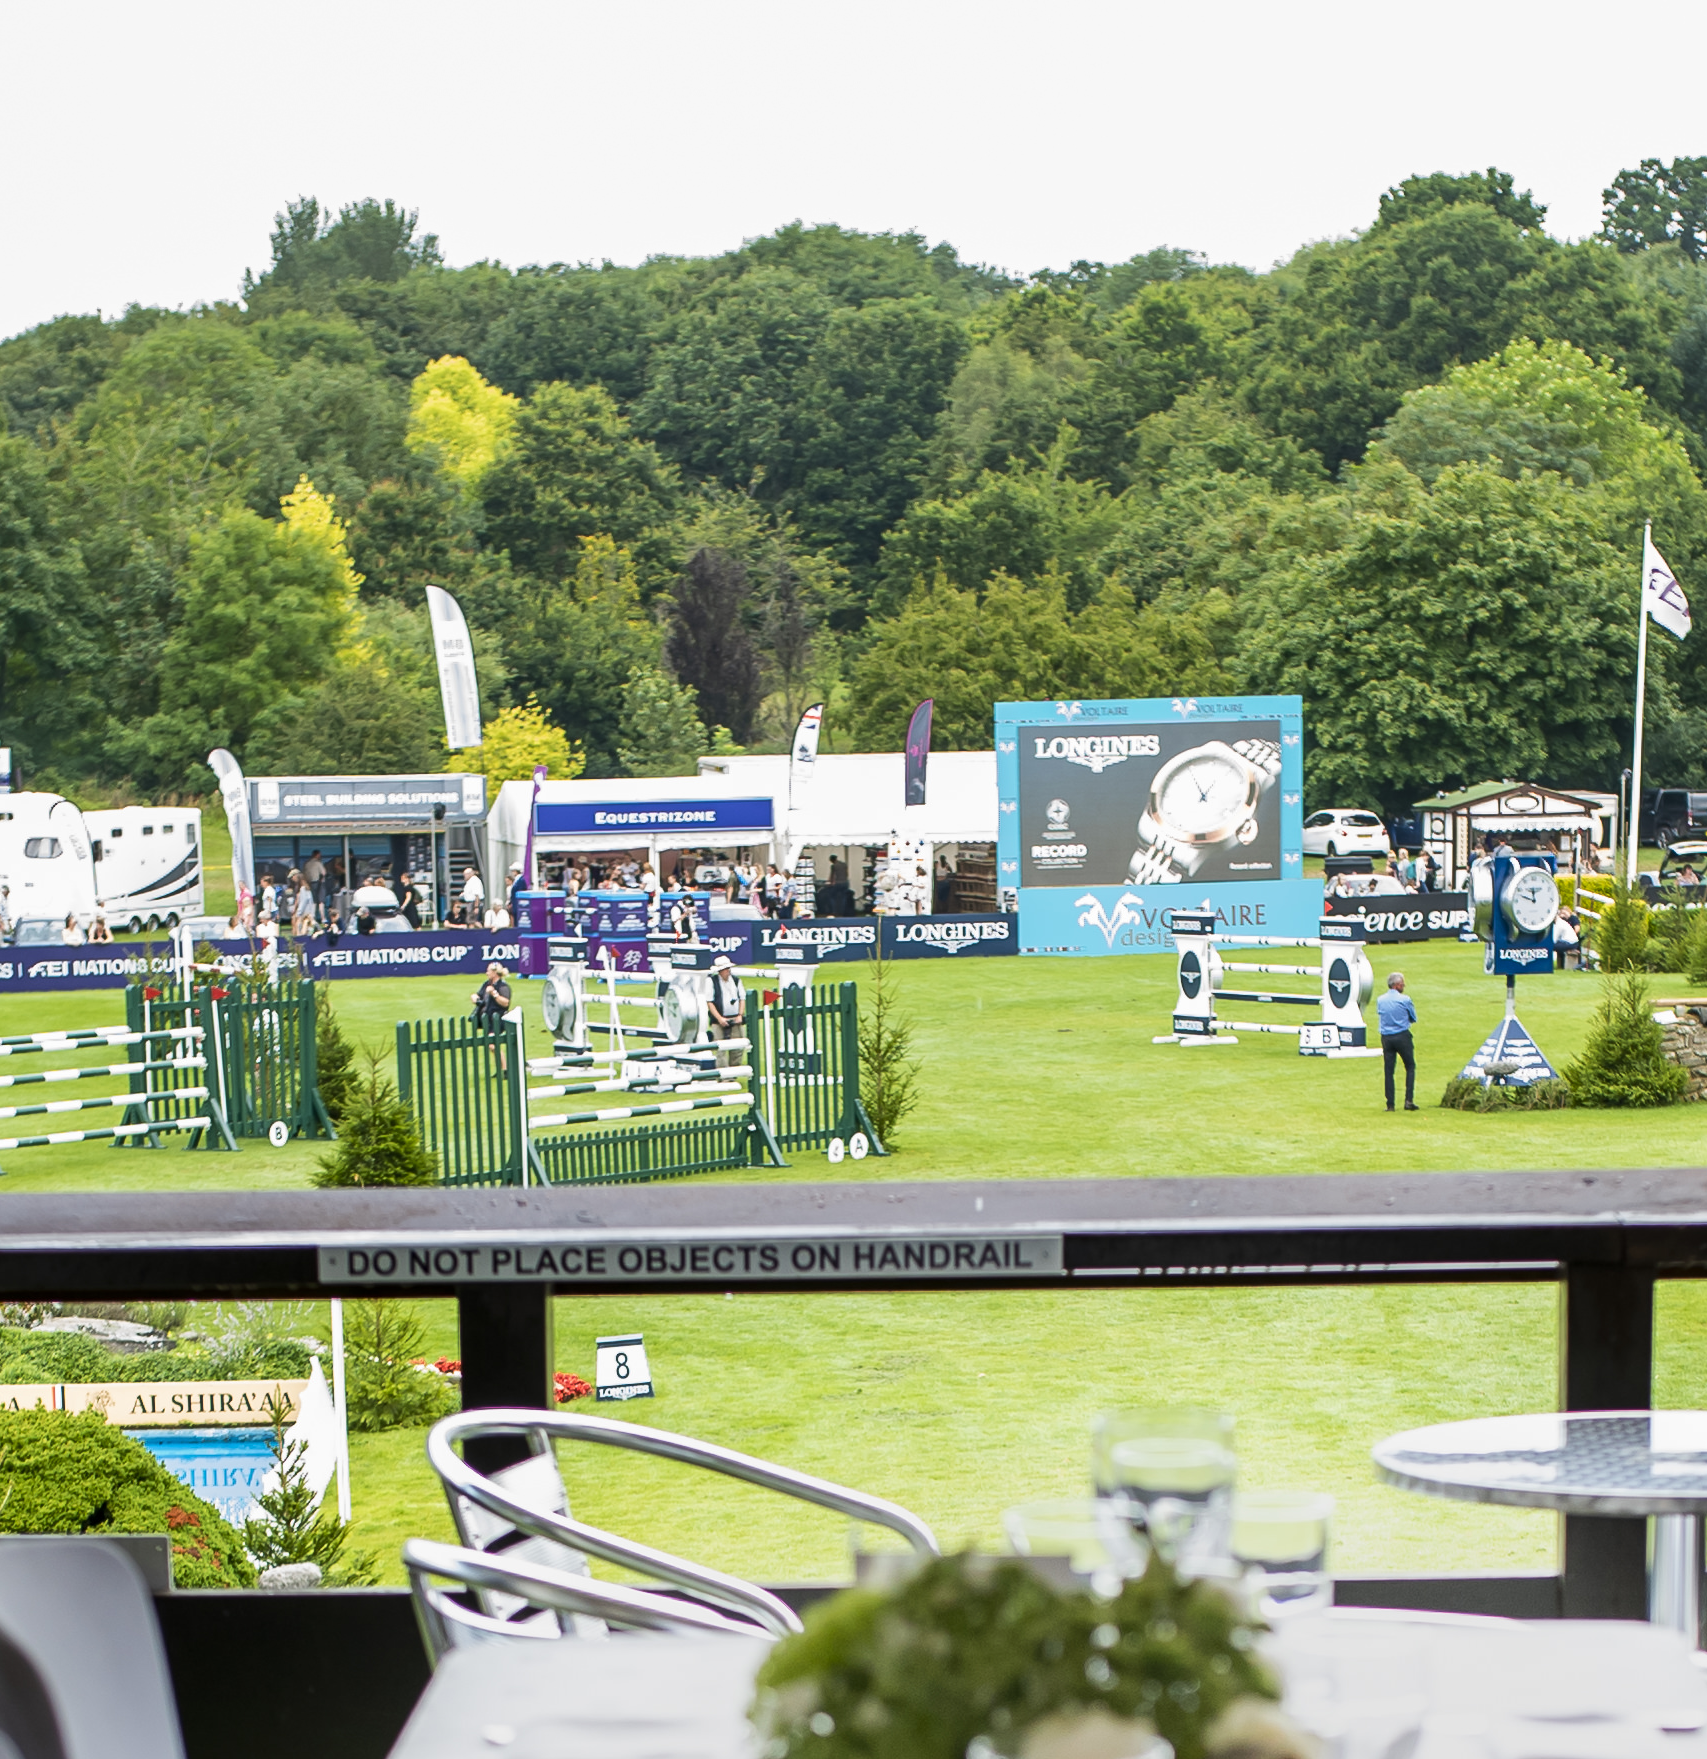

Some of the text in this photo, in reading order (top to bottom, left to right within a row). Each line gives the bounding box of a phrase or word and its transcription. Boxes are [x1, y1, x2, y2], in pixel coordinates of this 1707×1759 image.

[1034, 735, 1160, 758] LONGINES
[1031, 844, 1088, 858] RECORD
[1141, 903, 1267, 929] VOAIRE
[761, 926, 876, 947] LONGINES
[895, 921, 1010, 942] LONGINES
[1121, 928, 1175, 947] desig
[356, 947, 429, 965] NATIONS
[431, 945, 466, 961] CUP
[1499, 948, 1549, 960] LONGINES
[72, 957, 144, 977] NATIONS
[348, 1242, 1033, 1277] DO NOT PLACE OBJECTS ON HANDRAIL
[615, 1352, 630, 1379] 8
[130, 1395, 164, 1415] AL
